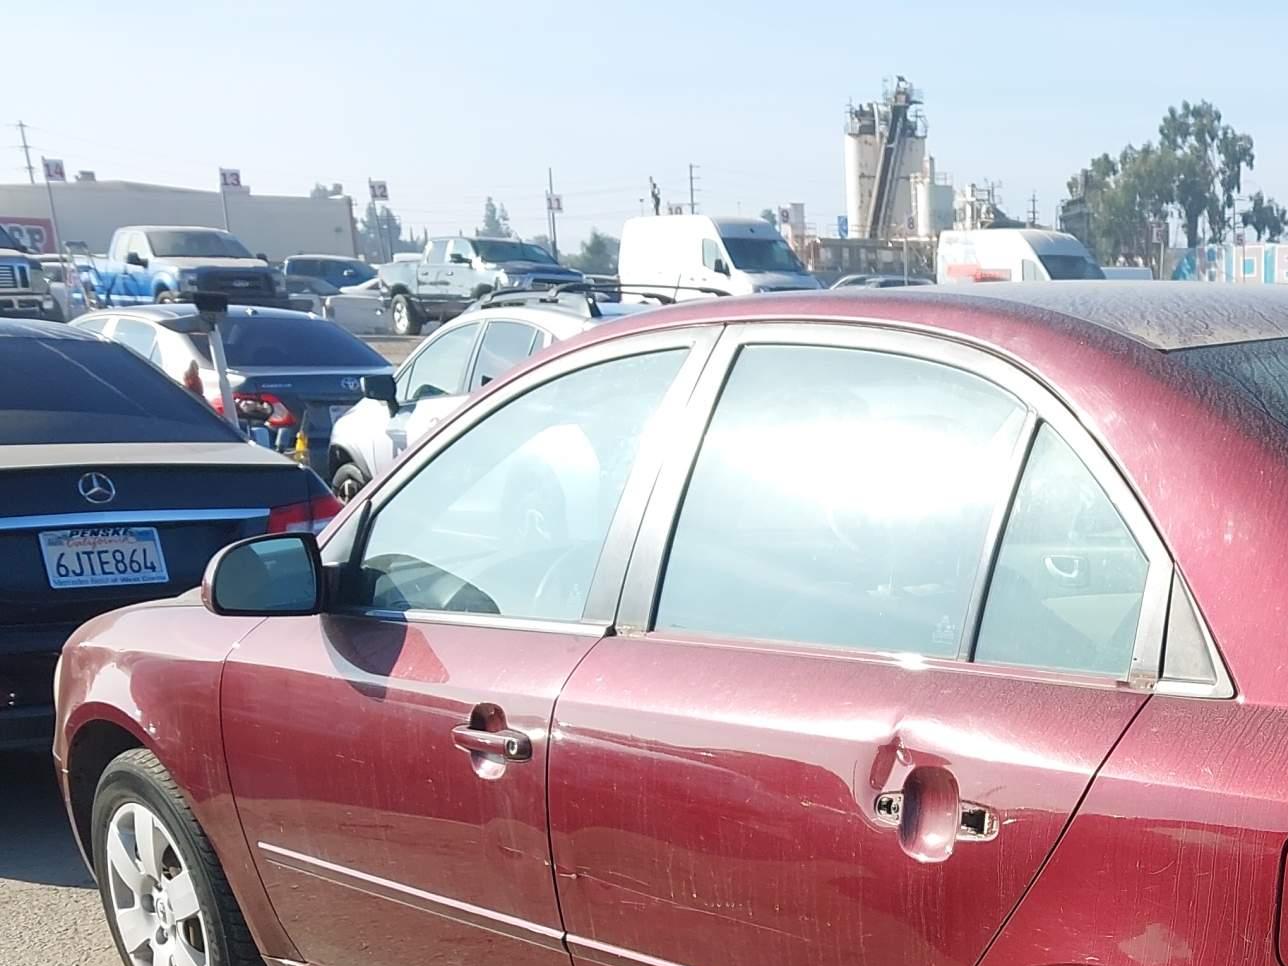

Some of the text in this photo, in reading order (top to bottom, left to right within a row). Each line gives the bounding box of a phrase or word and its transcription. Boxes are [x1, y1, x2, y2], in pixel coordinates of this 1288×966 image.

[44, 162, 64, 179] 14
[222, 172, 241, 187] 13
[370, 184, 388, 198] 12
[547, 197, 562, 211] 11
[781, 209, 790, 223] 9
[907, 216, 915, 230] 8
[55, 547, 157, 578] 6JTE864
